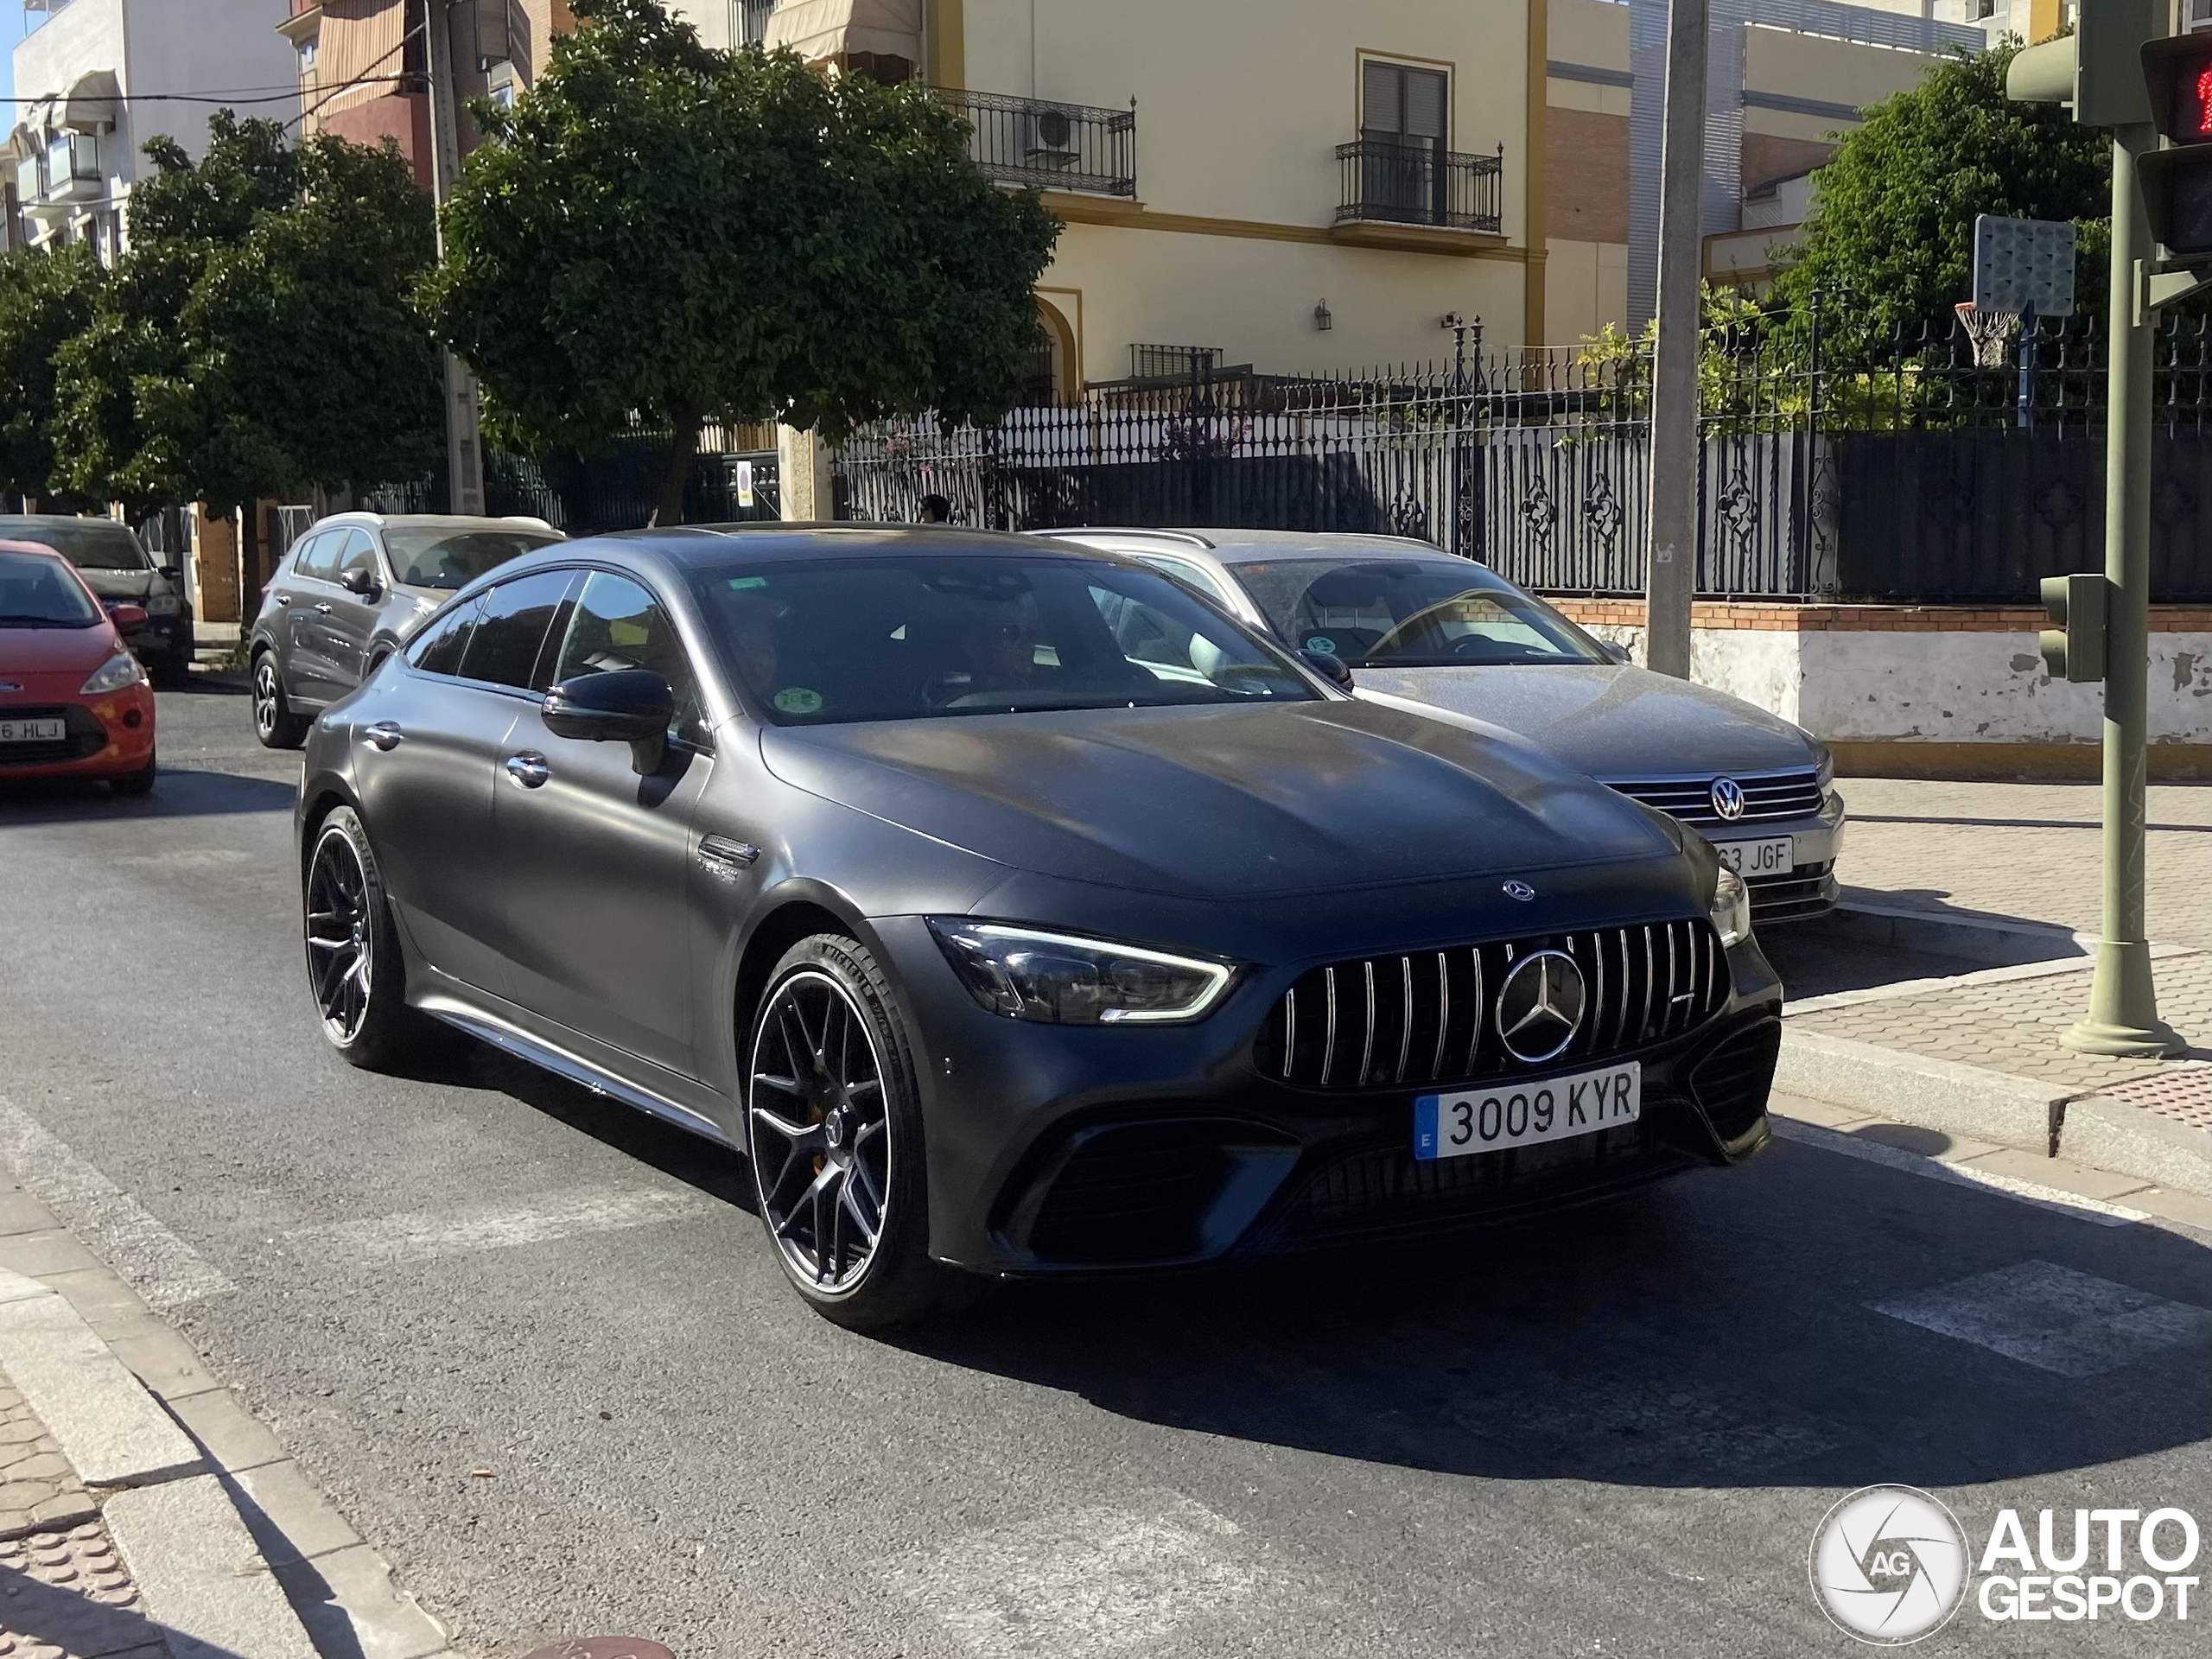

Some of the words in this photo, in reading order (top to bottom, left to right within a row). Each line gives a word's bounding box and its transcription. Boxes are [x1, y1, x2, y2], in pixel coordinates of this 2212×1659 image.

[23, 722, 58, 738] HLJ
[1751, 843, 1786, 870] JGF
[1450, 1090, 1554, 1145] 3009
[1568, 1072, 1631, 1127] KYR
[1421, 1134, 1432, 1147] E
